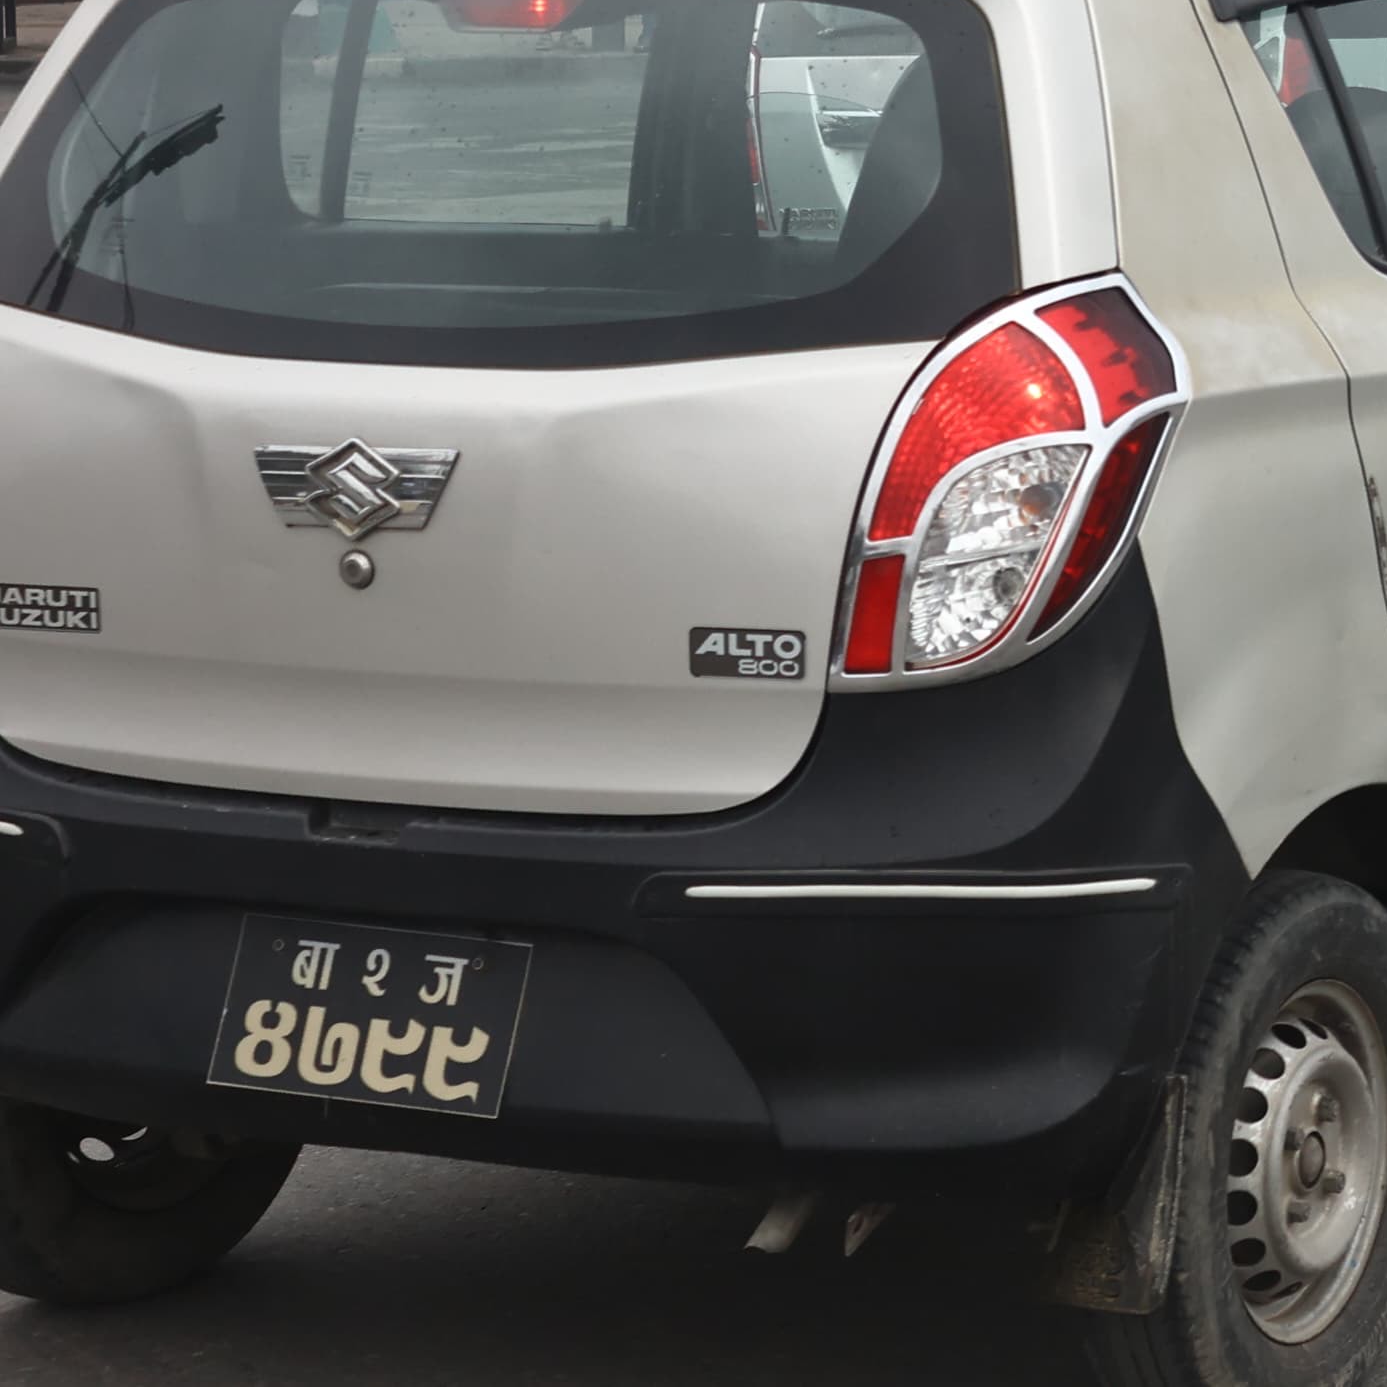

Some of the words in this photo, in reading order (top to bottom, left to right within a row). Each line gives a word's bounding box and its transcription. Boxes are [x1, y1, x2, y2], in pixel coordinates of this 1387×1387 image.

[0, 587, 97, 609] ARUTI
[0, 607, 97, 629] UZUKI
[694, 632, 802, 659] ALTO
[738, 659, 799, 676] 800
[292, 941, 340, 991] बा
[361, 949, 391, 997] २
[420, 955, 468, 1006] ज
[234, 999, 489, 1102] ४७९९
